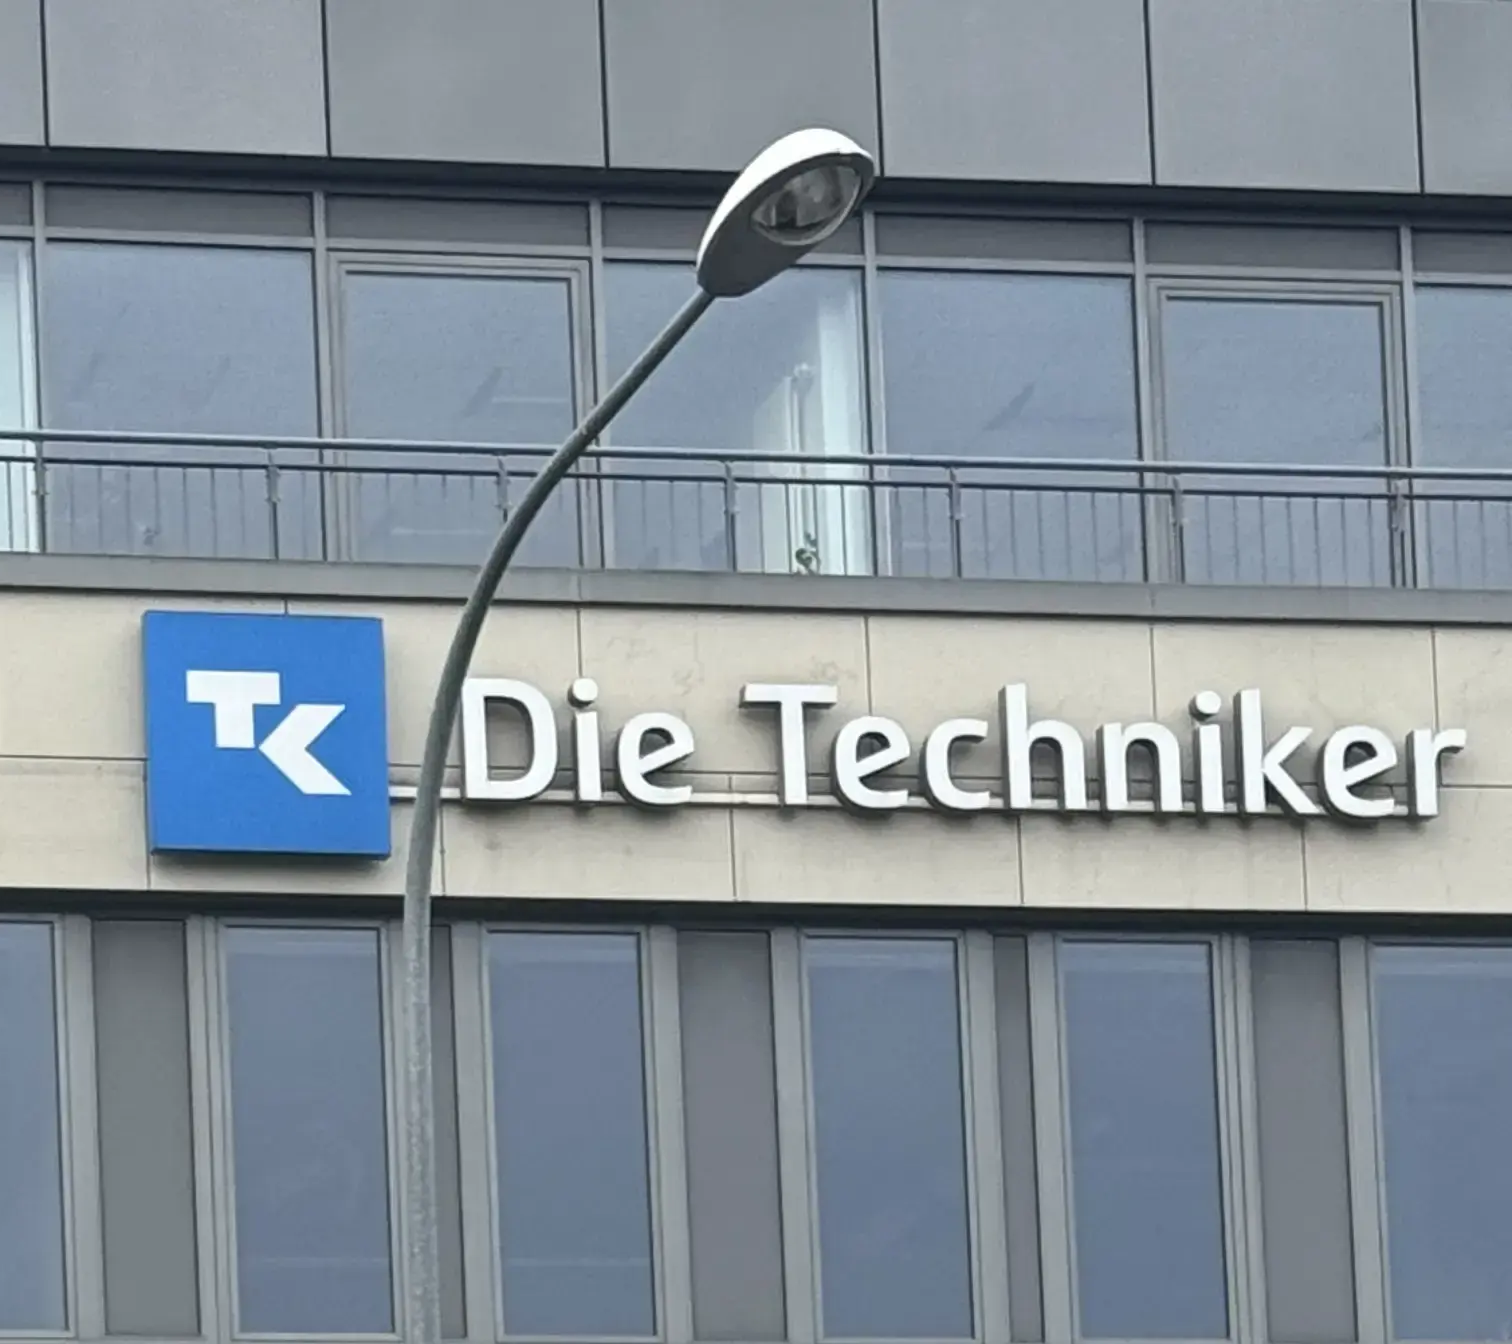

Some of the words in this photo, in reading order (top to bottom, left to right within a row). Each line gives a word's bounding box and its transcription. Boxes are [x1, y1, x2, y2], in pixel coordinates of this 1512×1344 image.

[186, 670, 352, 795] TK
[459, 676, 696, 807] Die
[740, 683, 1467, 820] Techniker
